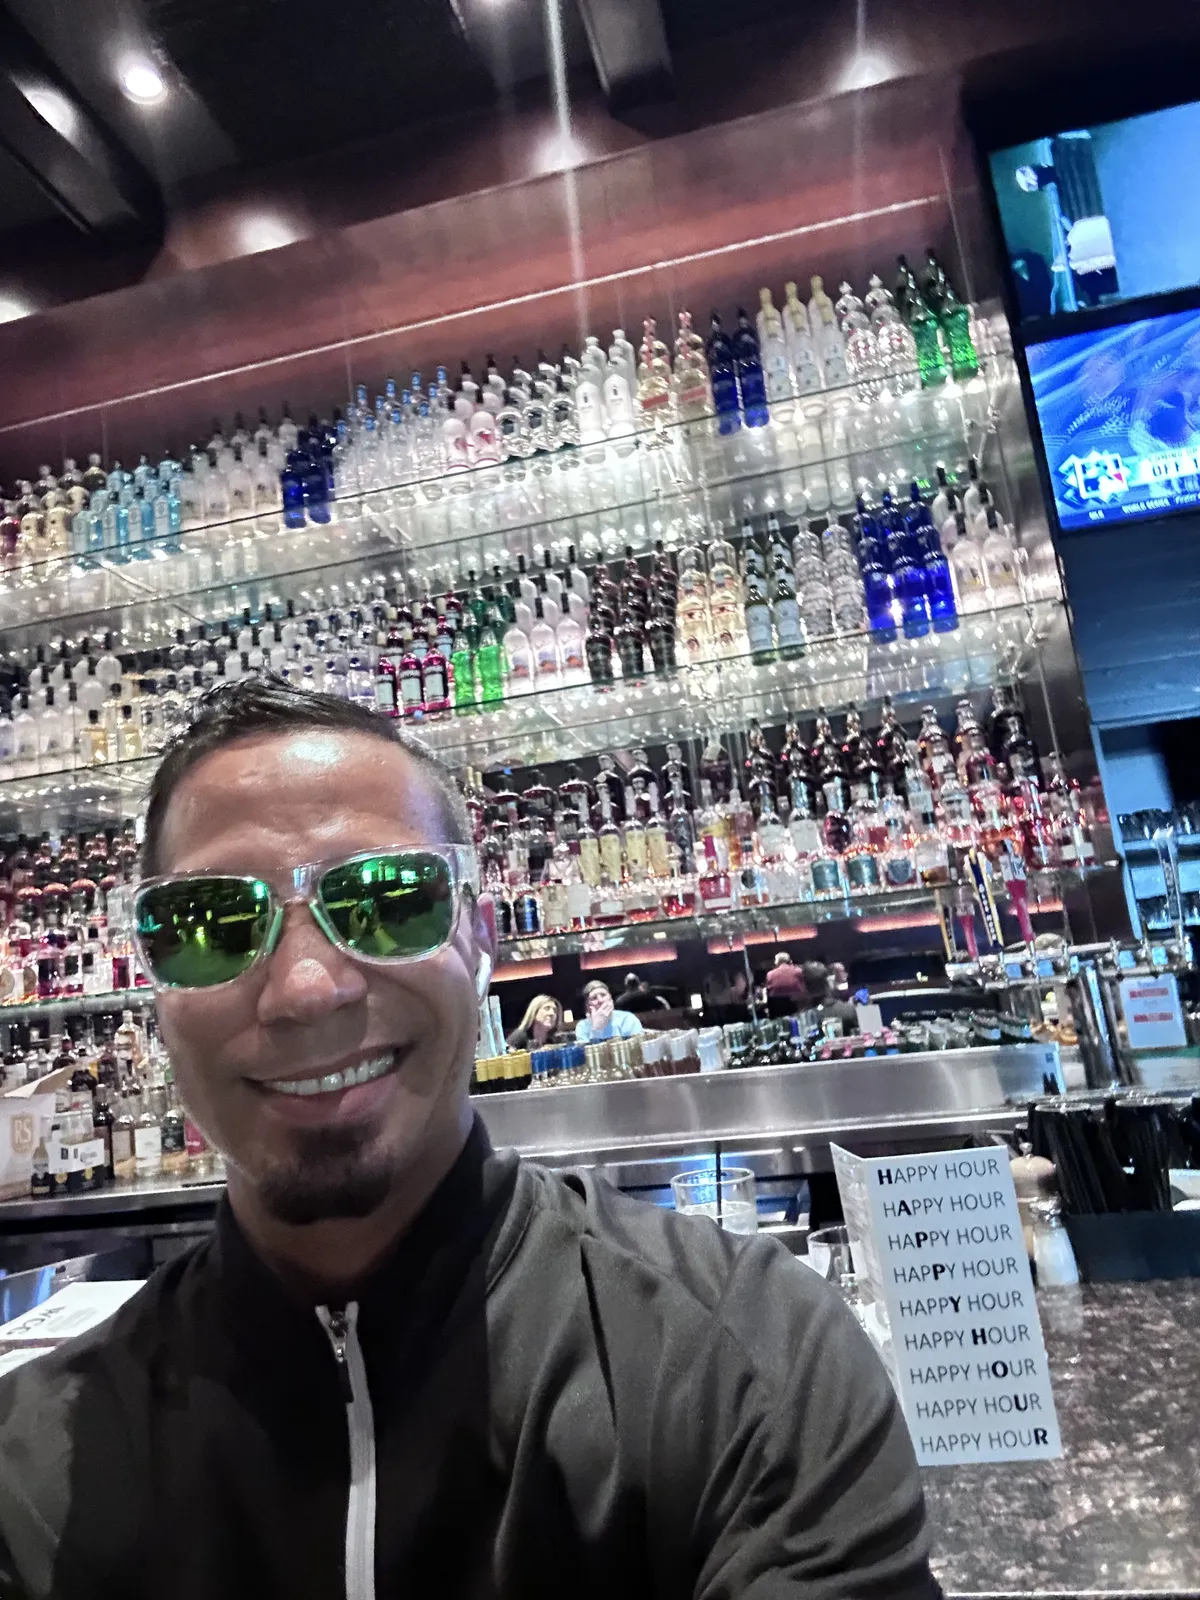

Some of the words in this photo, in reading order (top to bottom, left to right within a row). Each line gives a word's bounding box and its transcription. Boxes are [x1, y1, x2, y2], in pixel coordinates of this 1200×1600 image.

[877, 1164, 938, 1185] HAPPY
[945, 1157, 1000, 1179] HOUR
[883, 1196, 944, 1218] HAPPY
[950, 1191, 1006, 1212] HOUR
[888, 1230, 950, 1250] HAPPY
[956, 1223, 1013, 1245] HOUR
[893, 1262, 956, 1283] HAPPY
[962, 1256, 1019, 1278] HOUR
[900, 1295, 961, 1317] HAPPY
[967, 1289, 1024, 1312] HOUR
[904, 1329, 965, 1351] HAPPY
[971, 1324, 1031, 1346] HOUR
[910, 1365, 971, 1384] HAPPY
[977, 1358, 1037, 1380] HOUR
[916, 1398, 977, 1419] HAPPY
[984, 1392, 1042, 1414] HOUR
[920, 1433, 982, 1453] HAPPY
[988, 1427, 1049, 1449] HOUR
